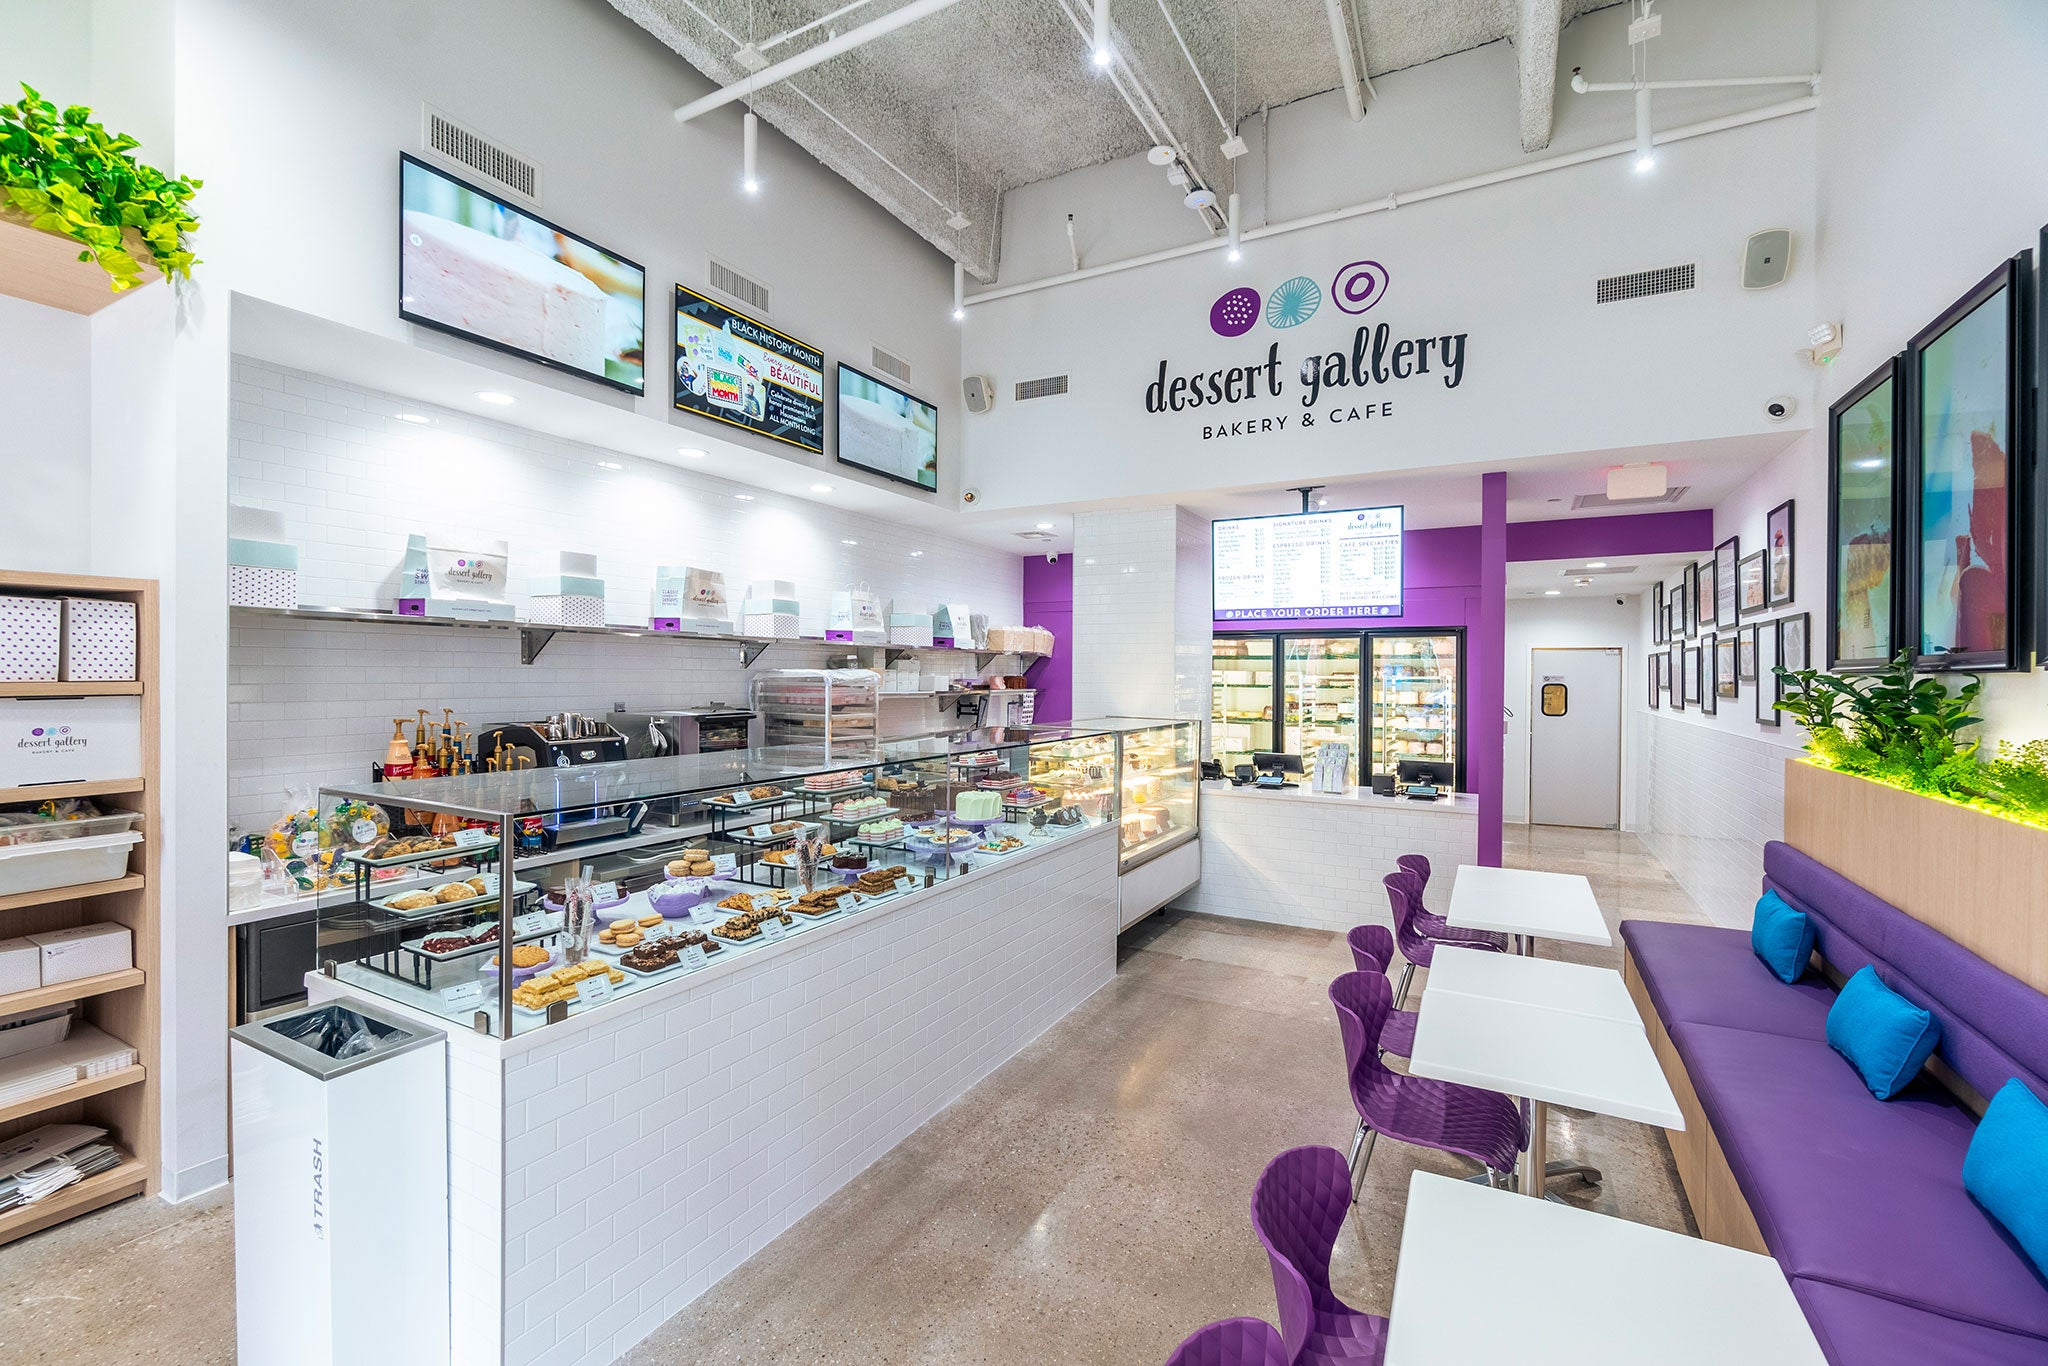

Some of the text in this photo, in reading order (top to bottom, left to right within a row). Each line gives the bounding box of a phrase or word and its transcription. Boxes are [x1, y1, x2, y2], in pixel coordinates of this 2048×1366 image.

[731, 319, 820, 366] BLACK HISTORY MONTH
[1145, 322, 1468, 413] dessert gallery
[712, 387, 739, 402] MONTH
[769, 414, 816, 436] ALL MONTH LONG
[1202, 402, 1393, 440] BAKERY & CAFE
[1235, 606, 1378, 618] PLACE YOUR ORDER HERE
[17, 736, 87, 748] dessert gallery
[312, 1137, 323, 1218] TRASH
